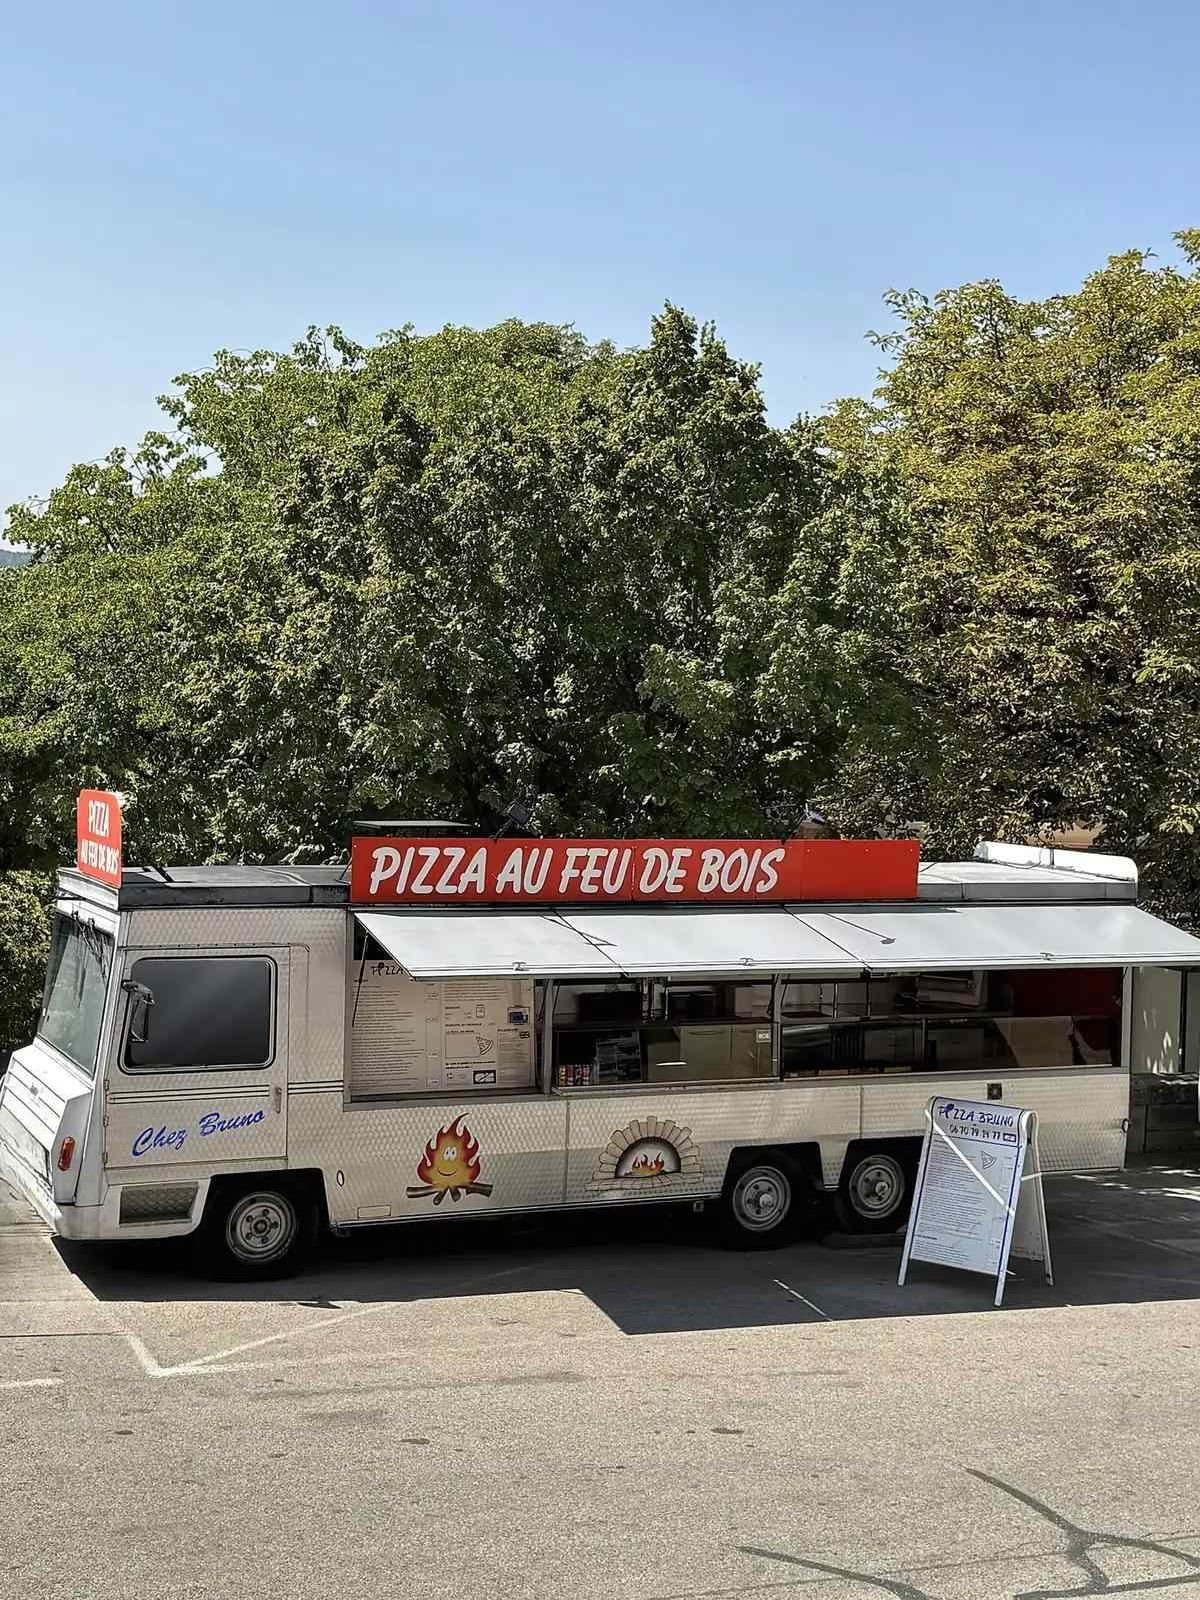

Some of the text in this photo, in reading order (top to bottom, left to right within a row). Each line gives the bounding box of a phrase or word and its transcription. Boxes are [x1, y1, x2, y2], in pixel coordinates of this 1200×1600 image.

[88, 800, 110, 838] PIZZA
[369, 846, 786, 894] PIZZA AU FEU DE BOIS
[132, 1109, 265, 1157] Chez Bruno
[937, 1103, 1014, 1127] PIZZA BRUNO
